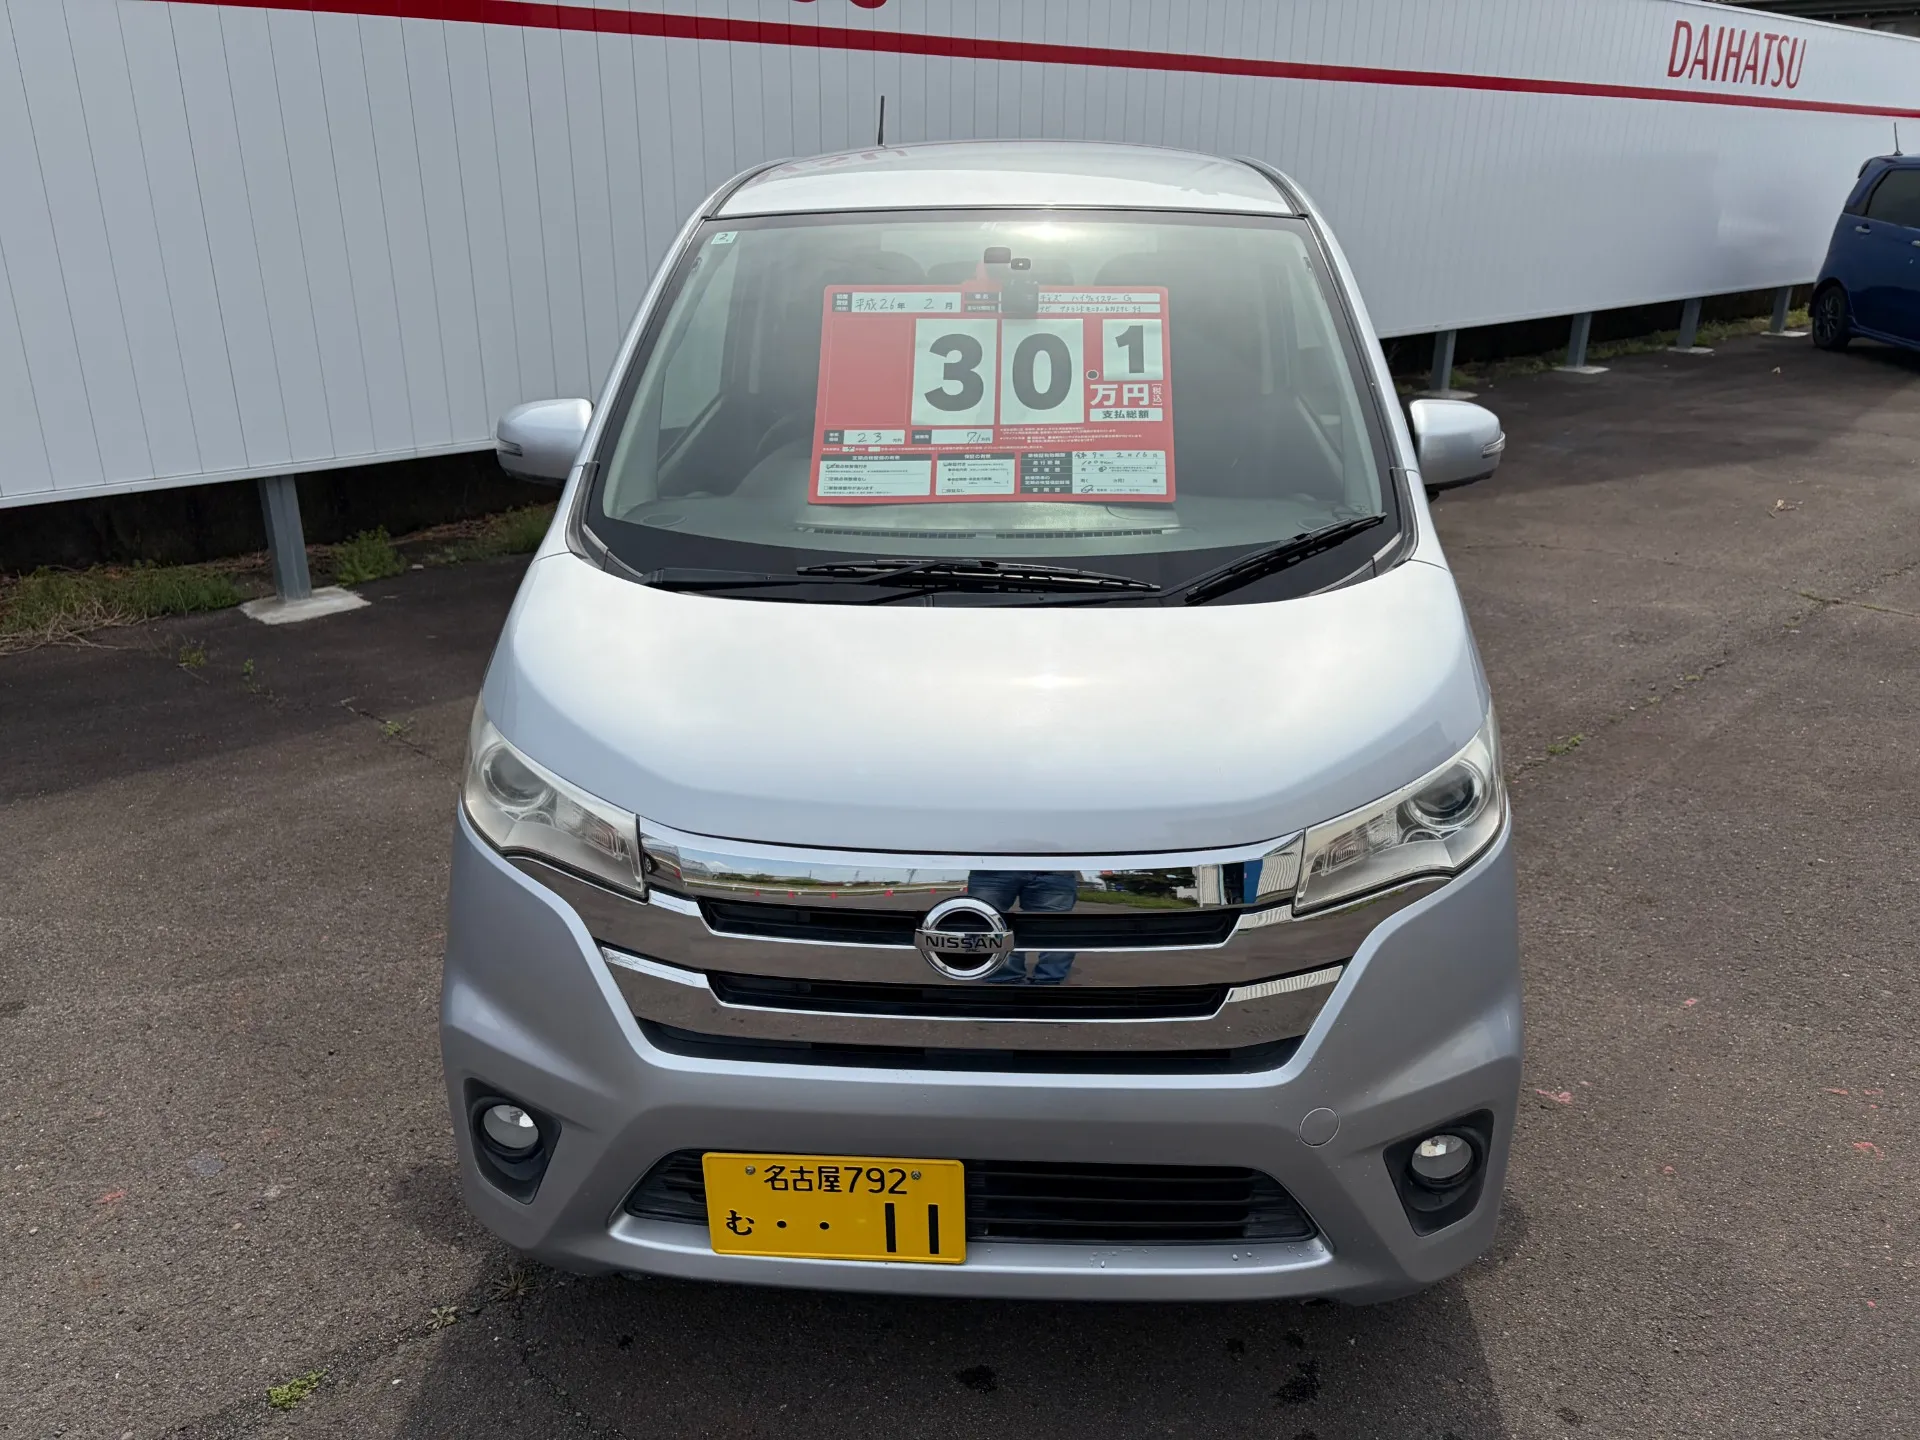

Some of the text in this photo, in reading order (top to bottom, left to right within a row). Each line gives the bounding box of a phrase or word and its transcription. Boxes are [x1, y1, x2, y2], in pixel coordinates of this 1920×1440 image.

[1667, 20, 1807, 89] DAIHATSU
[924, 298, 934, 310] 2
[945, 299, 953, 309] 月
[1089, 384, 1149, 406] 万円
[1102, 410, 1149, 419] 支払総額
[925, 935, 1003, 949] NISSAN
[764, 1164, 908, 1195] 名古屋792
[726, 1209, 755, 1236] む
